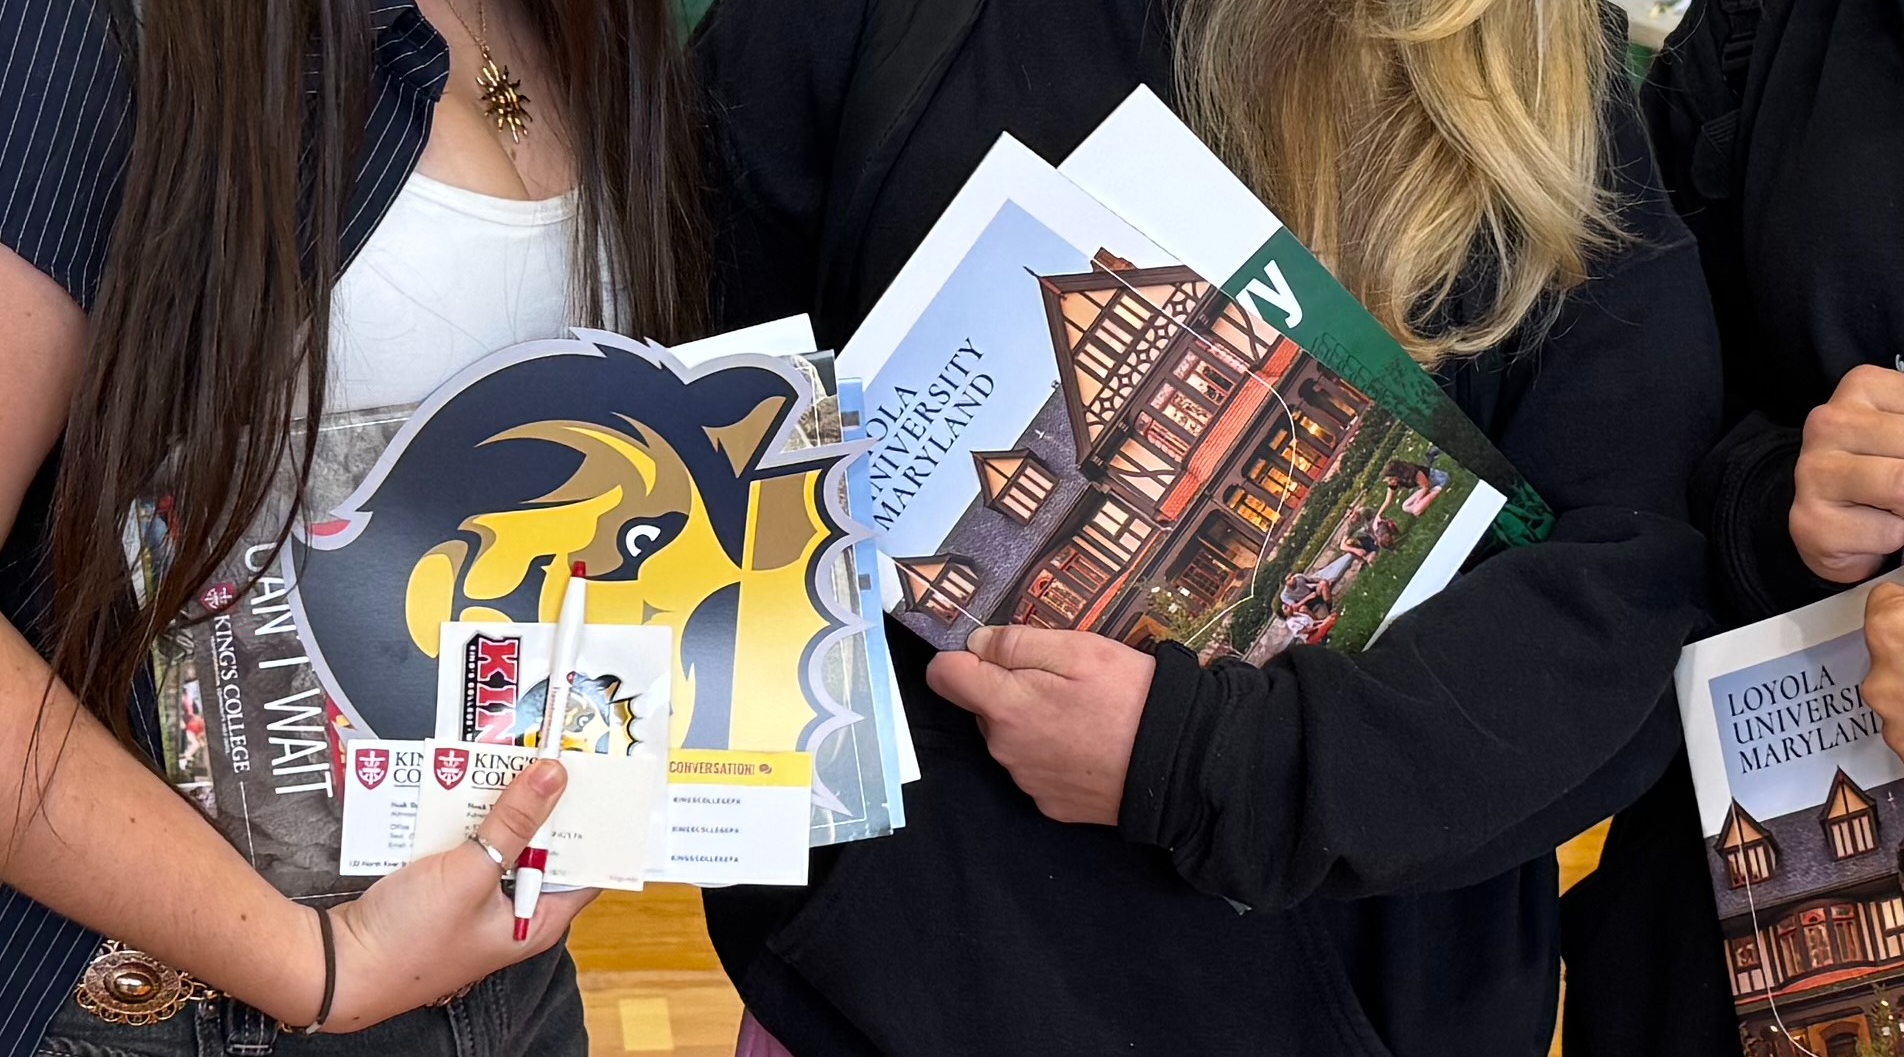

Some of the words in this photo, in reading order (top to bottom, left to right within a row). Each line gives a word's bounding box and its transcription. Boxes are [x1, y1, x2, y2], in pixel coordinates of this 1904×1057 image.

[865, 385, 919, 442] OLA
[869, 337, 984, 502] NIVERSITY
[873, 374, 995, 532] MARYLAND
[214, 615, 239, 681] KING'S
[475, 637, 519, 746] KIN
[1728, 664, 1835, 717] LOYOLA
[1733, 682, 1865, 745] UNIVERSI
[223, 683, 251, 774] COLLEGE
[264, 688, 334, 798] WAIT
[395, 751, 424, 767] KIN
[669, 760, 756, 776] CONVERSATION!
